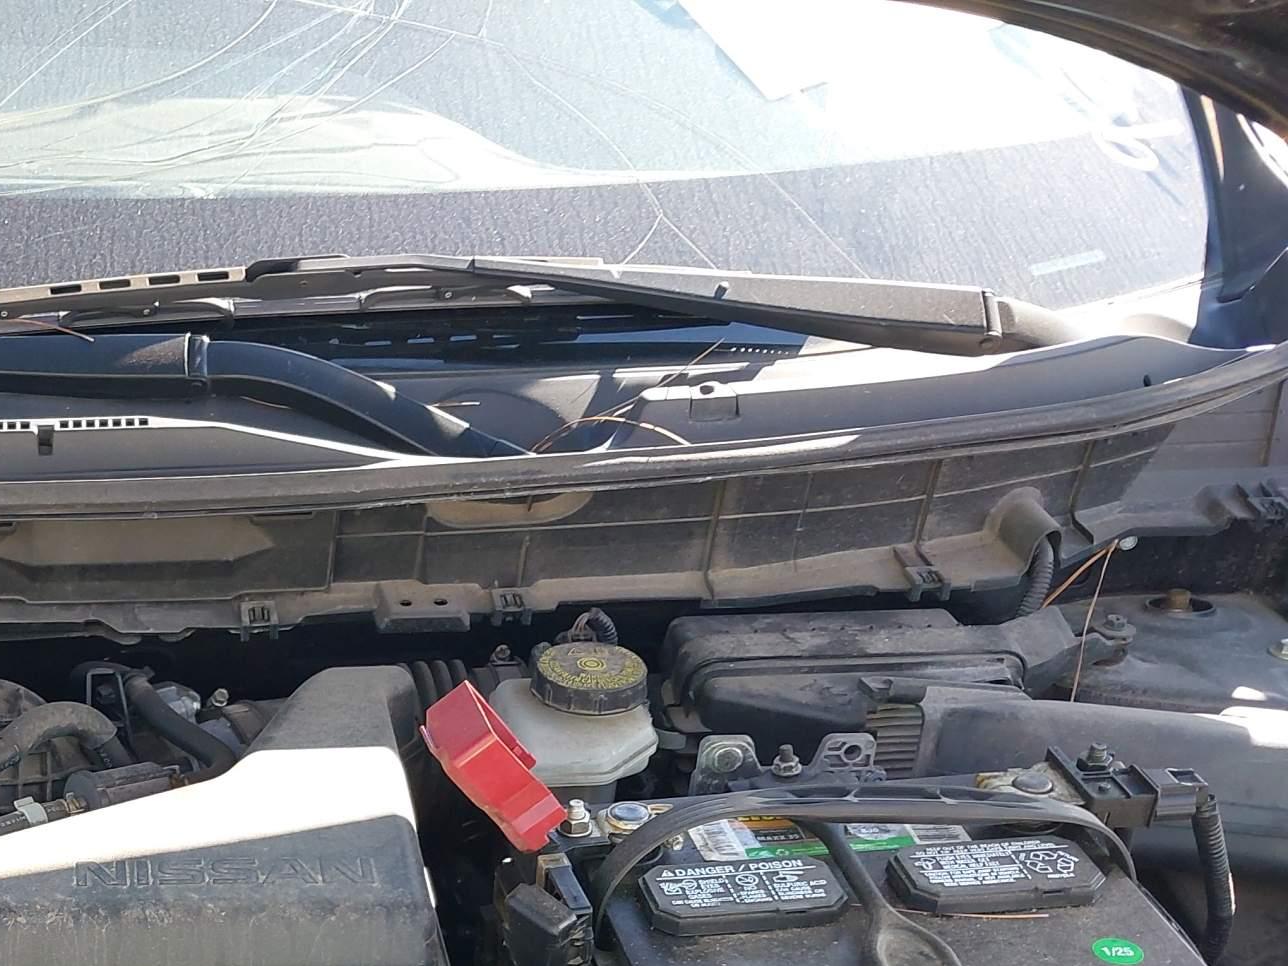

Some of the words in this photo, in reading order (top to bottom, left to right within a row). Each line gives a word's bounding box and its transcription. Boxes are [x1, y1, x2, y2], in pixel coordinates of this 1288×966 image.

[72, 855, 381, 887] NISSAN
[675, 865, 735, 877] DANGER
[750, 859, 803, 871] POISON
